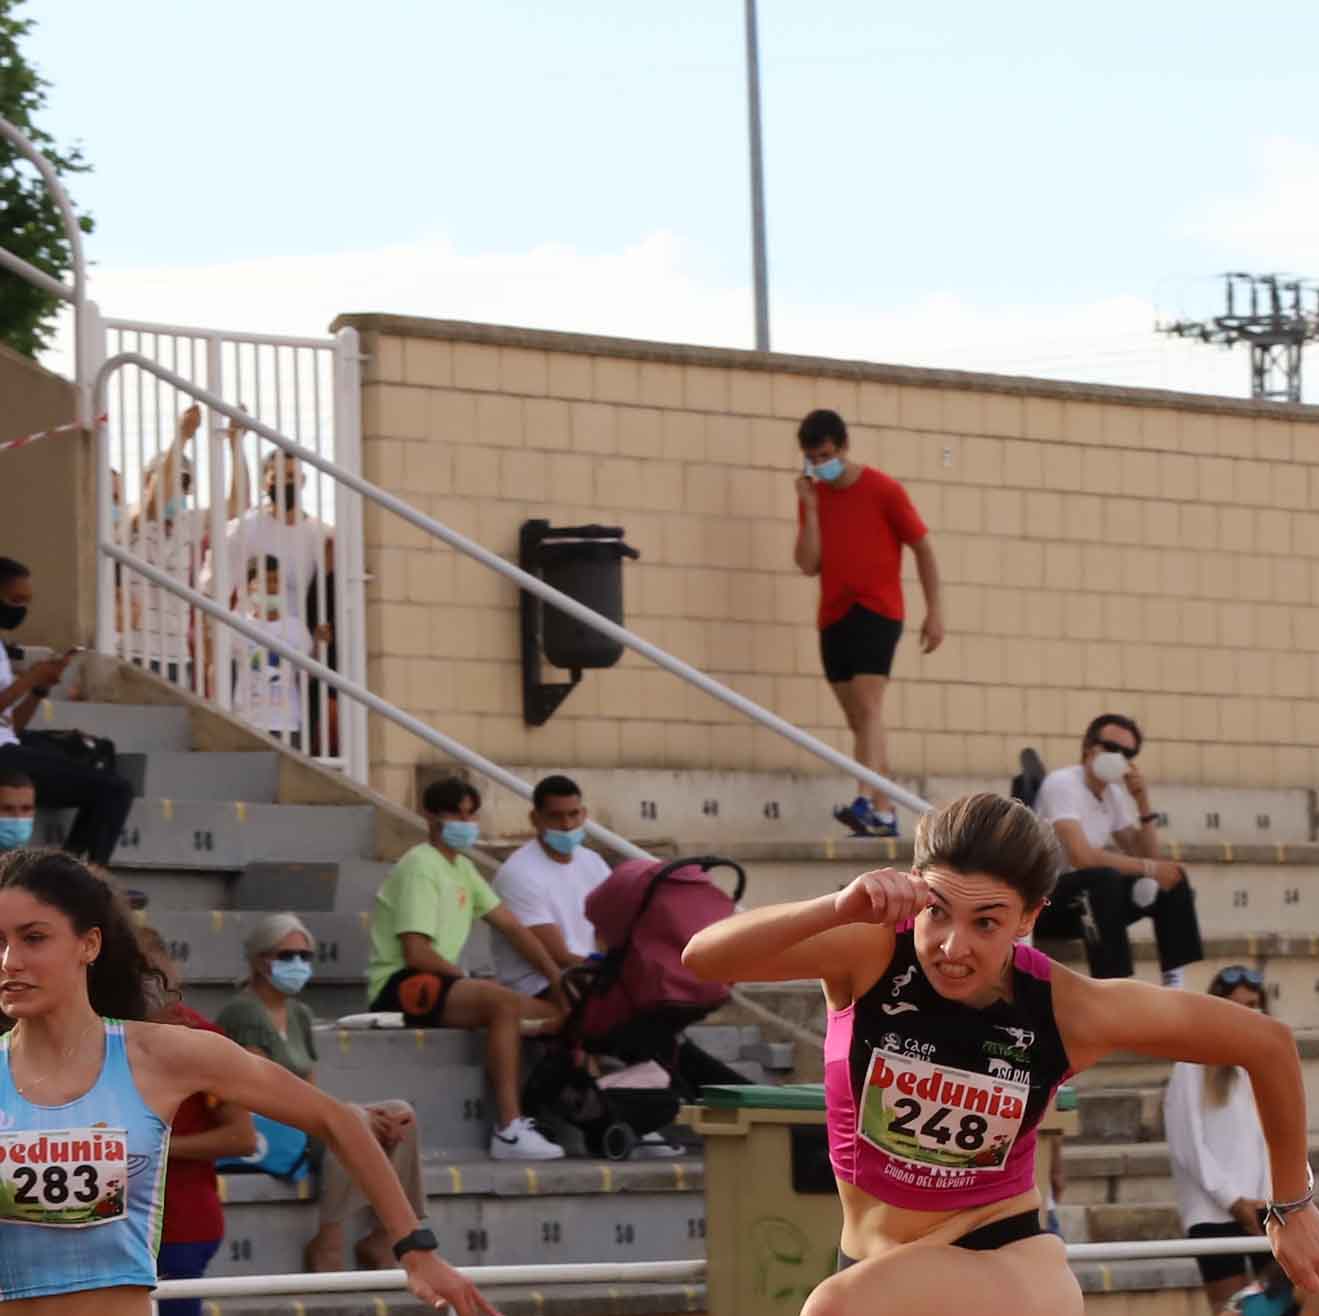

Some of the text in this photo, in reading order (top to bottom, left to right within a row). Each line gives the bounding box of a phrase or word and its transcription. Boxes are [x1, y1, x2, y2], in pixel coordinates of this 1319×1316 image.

[869, 1056, 1024, 1120] bedunia
[888, 1098, 988, 1150] 248
[13, 1164, 99, 1205] 283
[884, 1163, 915, 1185] CIUDAD
[916, 1175, 934, 1188] DEL
